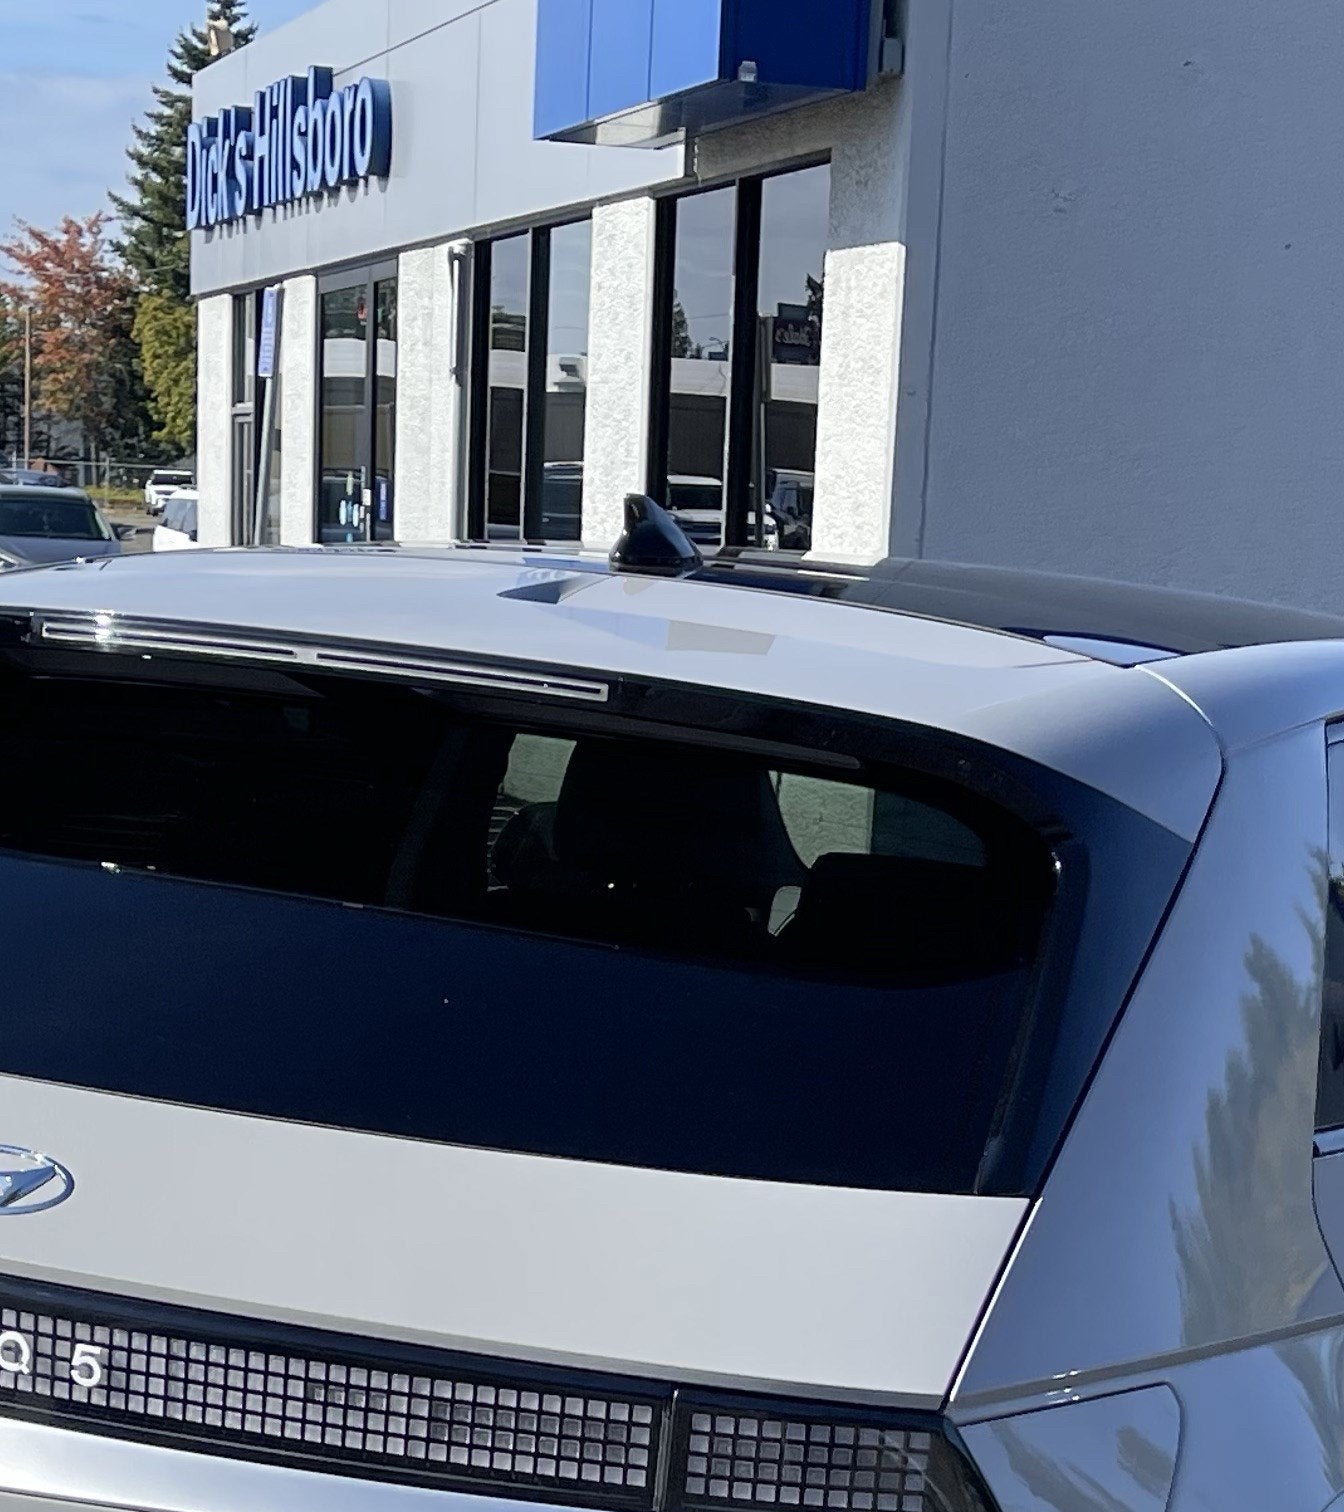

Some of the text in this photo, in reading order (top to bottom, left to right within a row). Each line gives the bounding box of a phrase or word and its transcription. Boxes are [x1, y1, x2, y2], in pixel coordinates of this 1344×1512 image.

[186, 65, 376, 231] Dick's Hillsboro
[69, 1343, 104, 1388] 5
